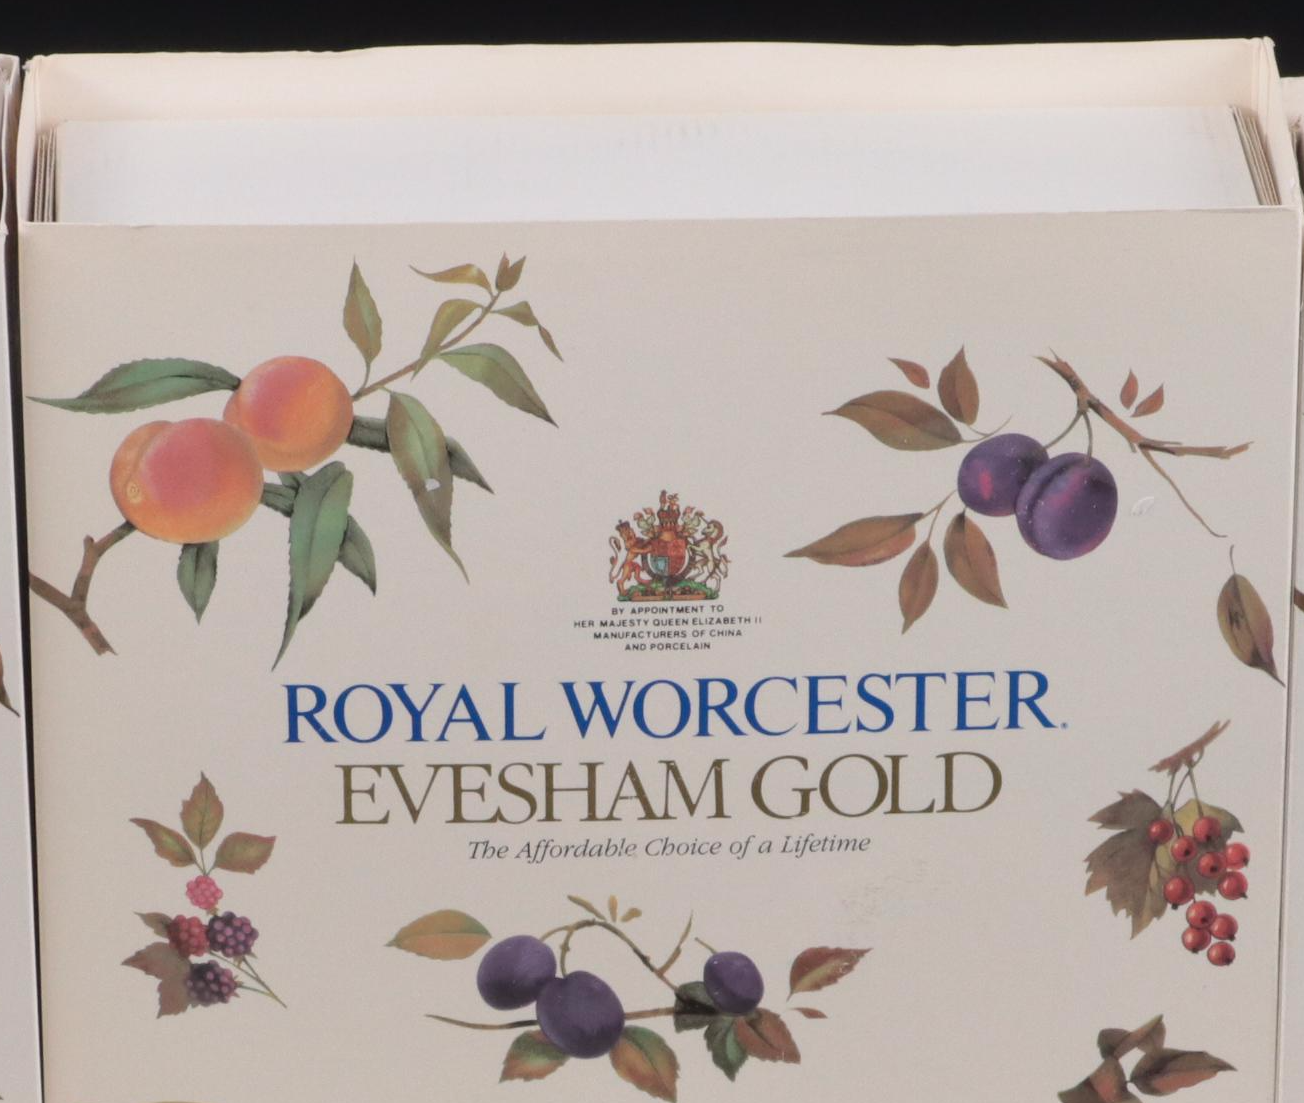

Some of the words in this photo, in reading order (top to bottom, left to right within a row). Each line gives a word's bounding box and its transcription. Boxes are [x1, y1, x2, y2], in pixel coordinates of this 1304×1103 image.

[285, 682, 545, 744] ROYAL
[335, 758, 731, 825] EVESHAM
[750, 751, 1003, 820] GOLD
[469, 840, 509, 860] The
[515, 838, 637, 864] Affordable
[644, 836, 723, 857] Choice
[729, 834, 756, 860] of
[757, 840, 773, 854] a
[780, 832, 871, 859] Lifetime
